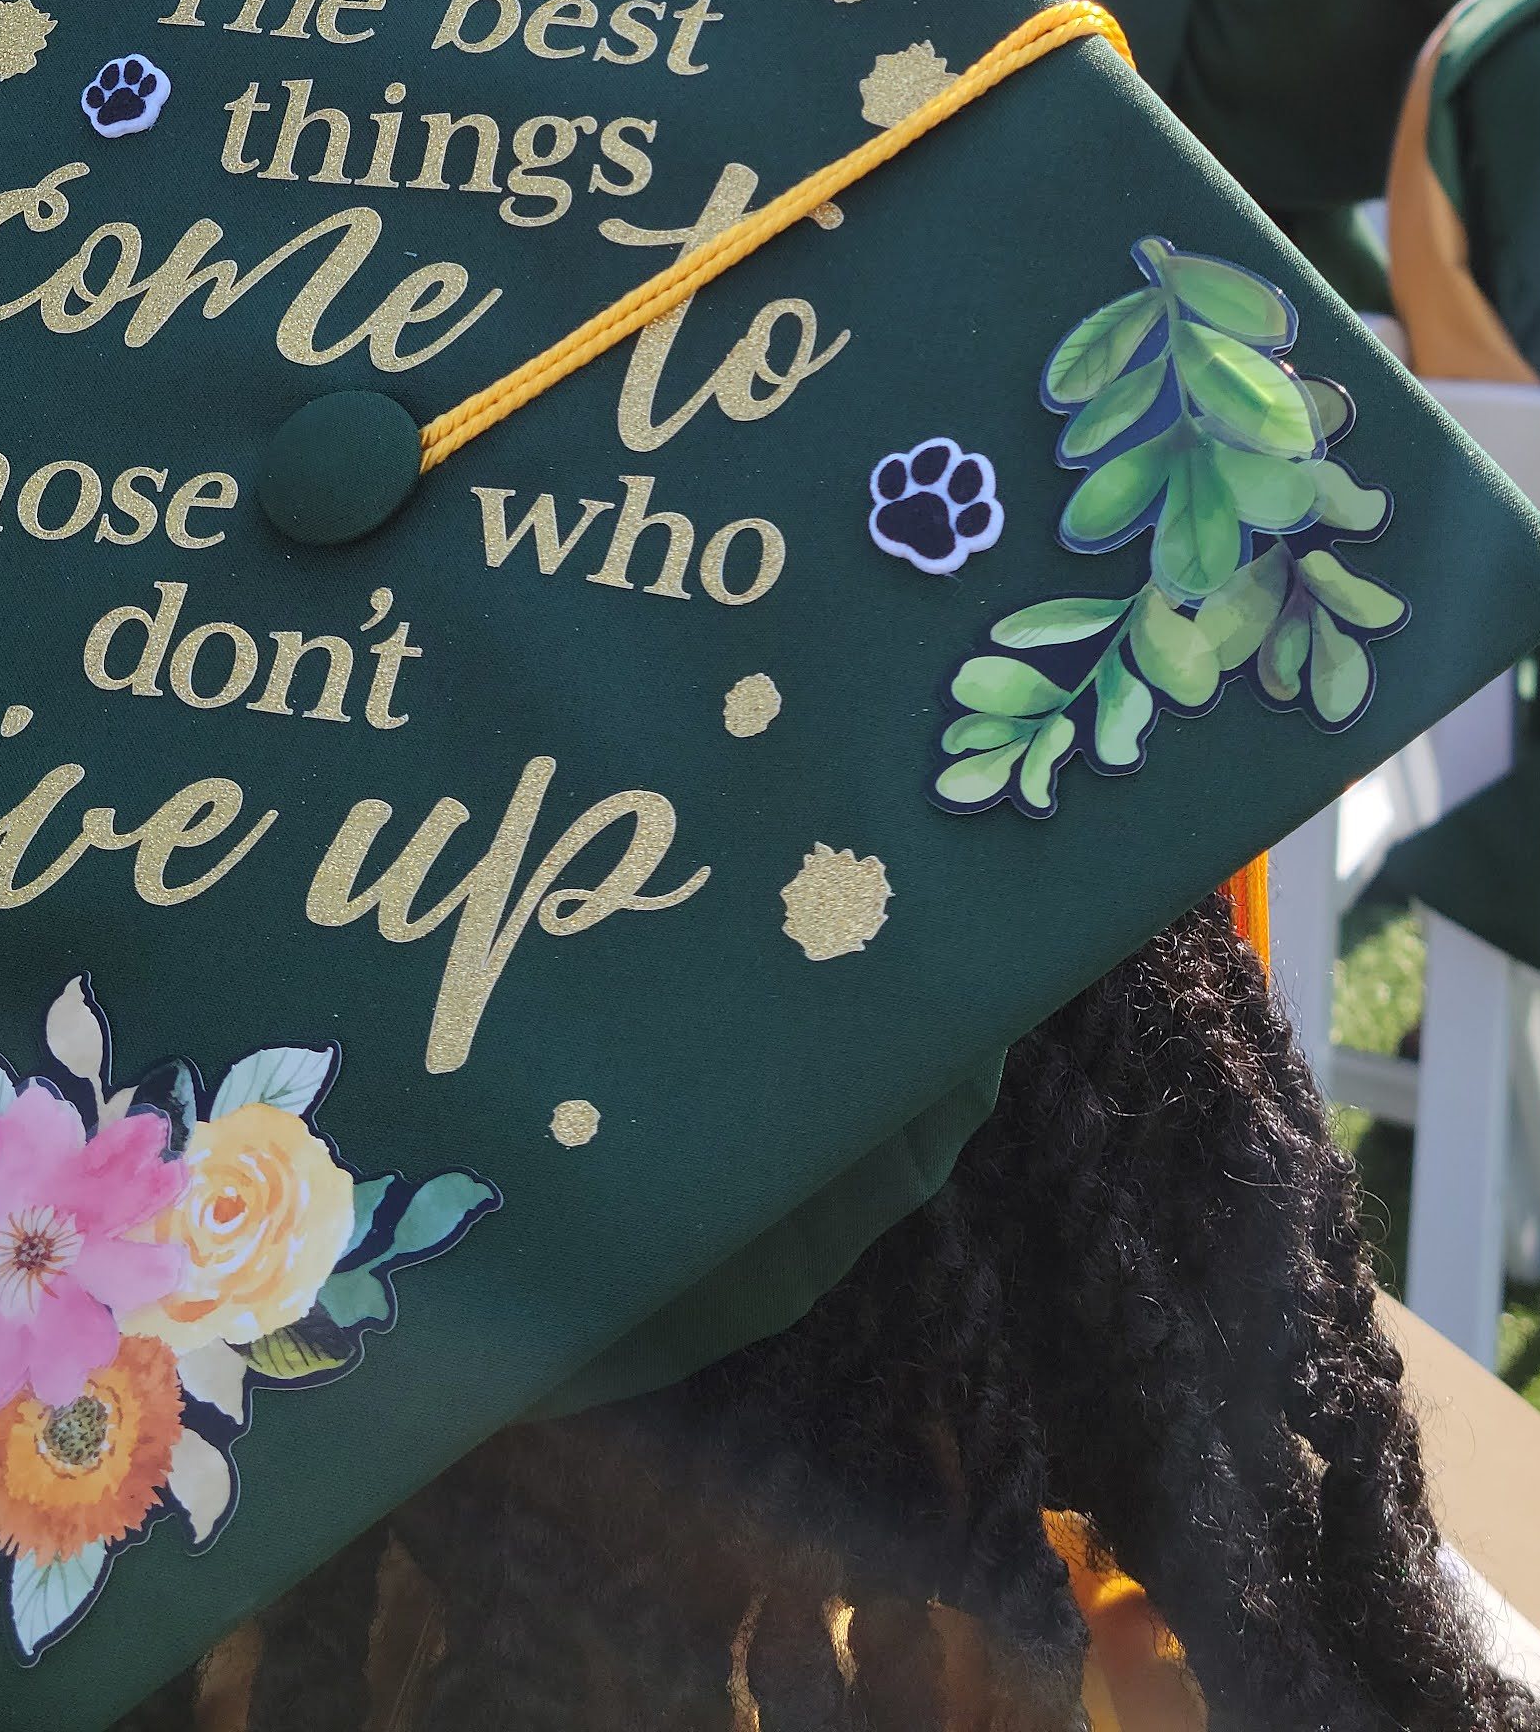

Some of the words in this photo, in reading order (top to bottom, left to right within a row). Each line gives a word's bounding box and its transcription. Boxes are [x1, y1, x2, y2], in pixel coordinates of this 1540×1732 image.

[220, 80, 660, 226] things
[599, 162, 850, 451] to
[471, 475, 785, 605] who
[84, 582, 423, 729] don't
[306, 757, 712, 1073] up
